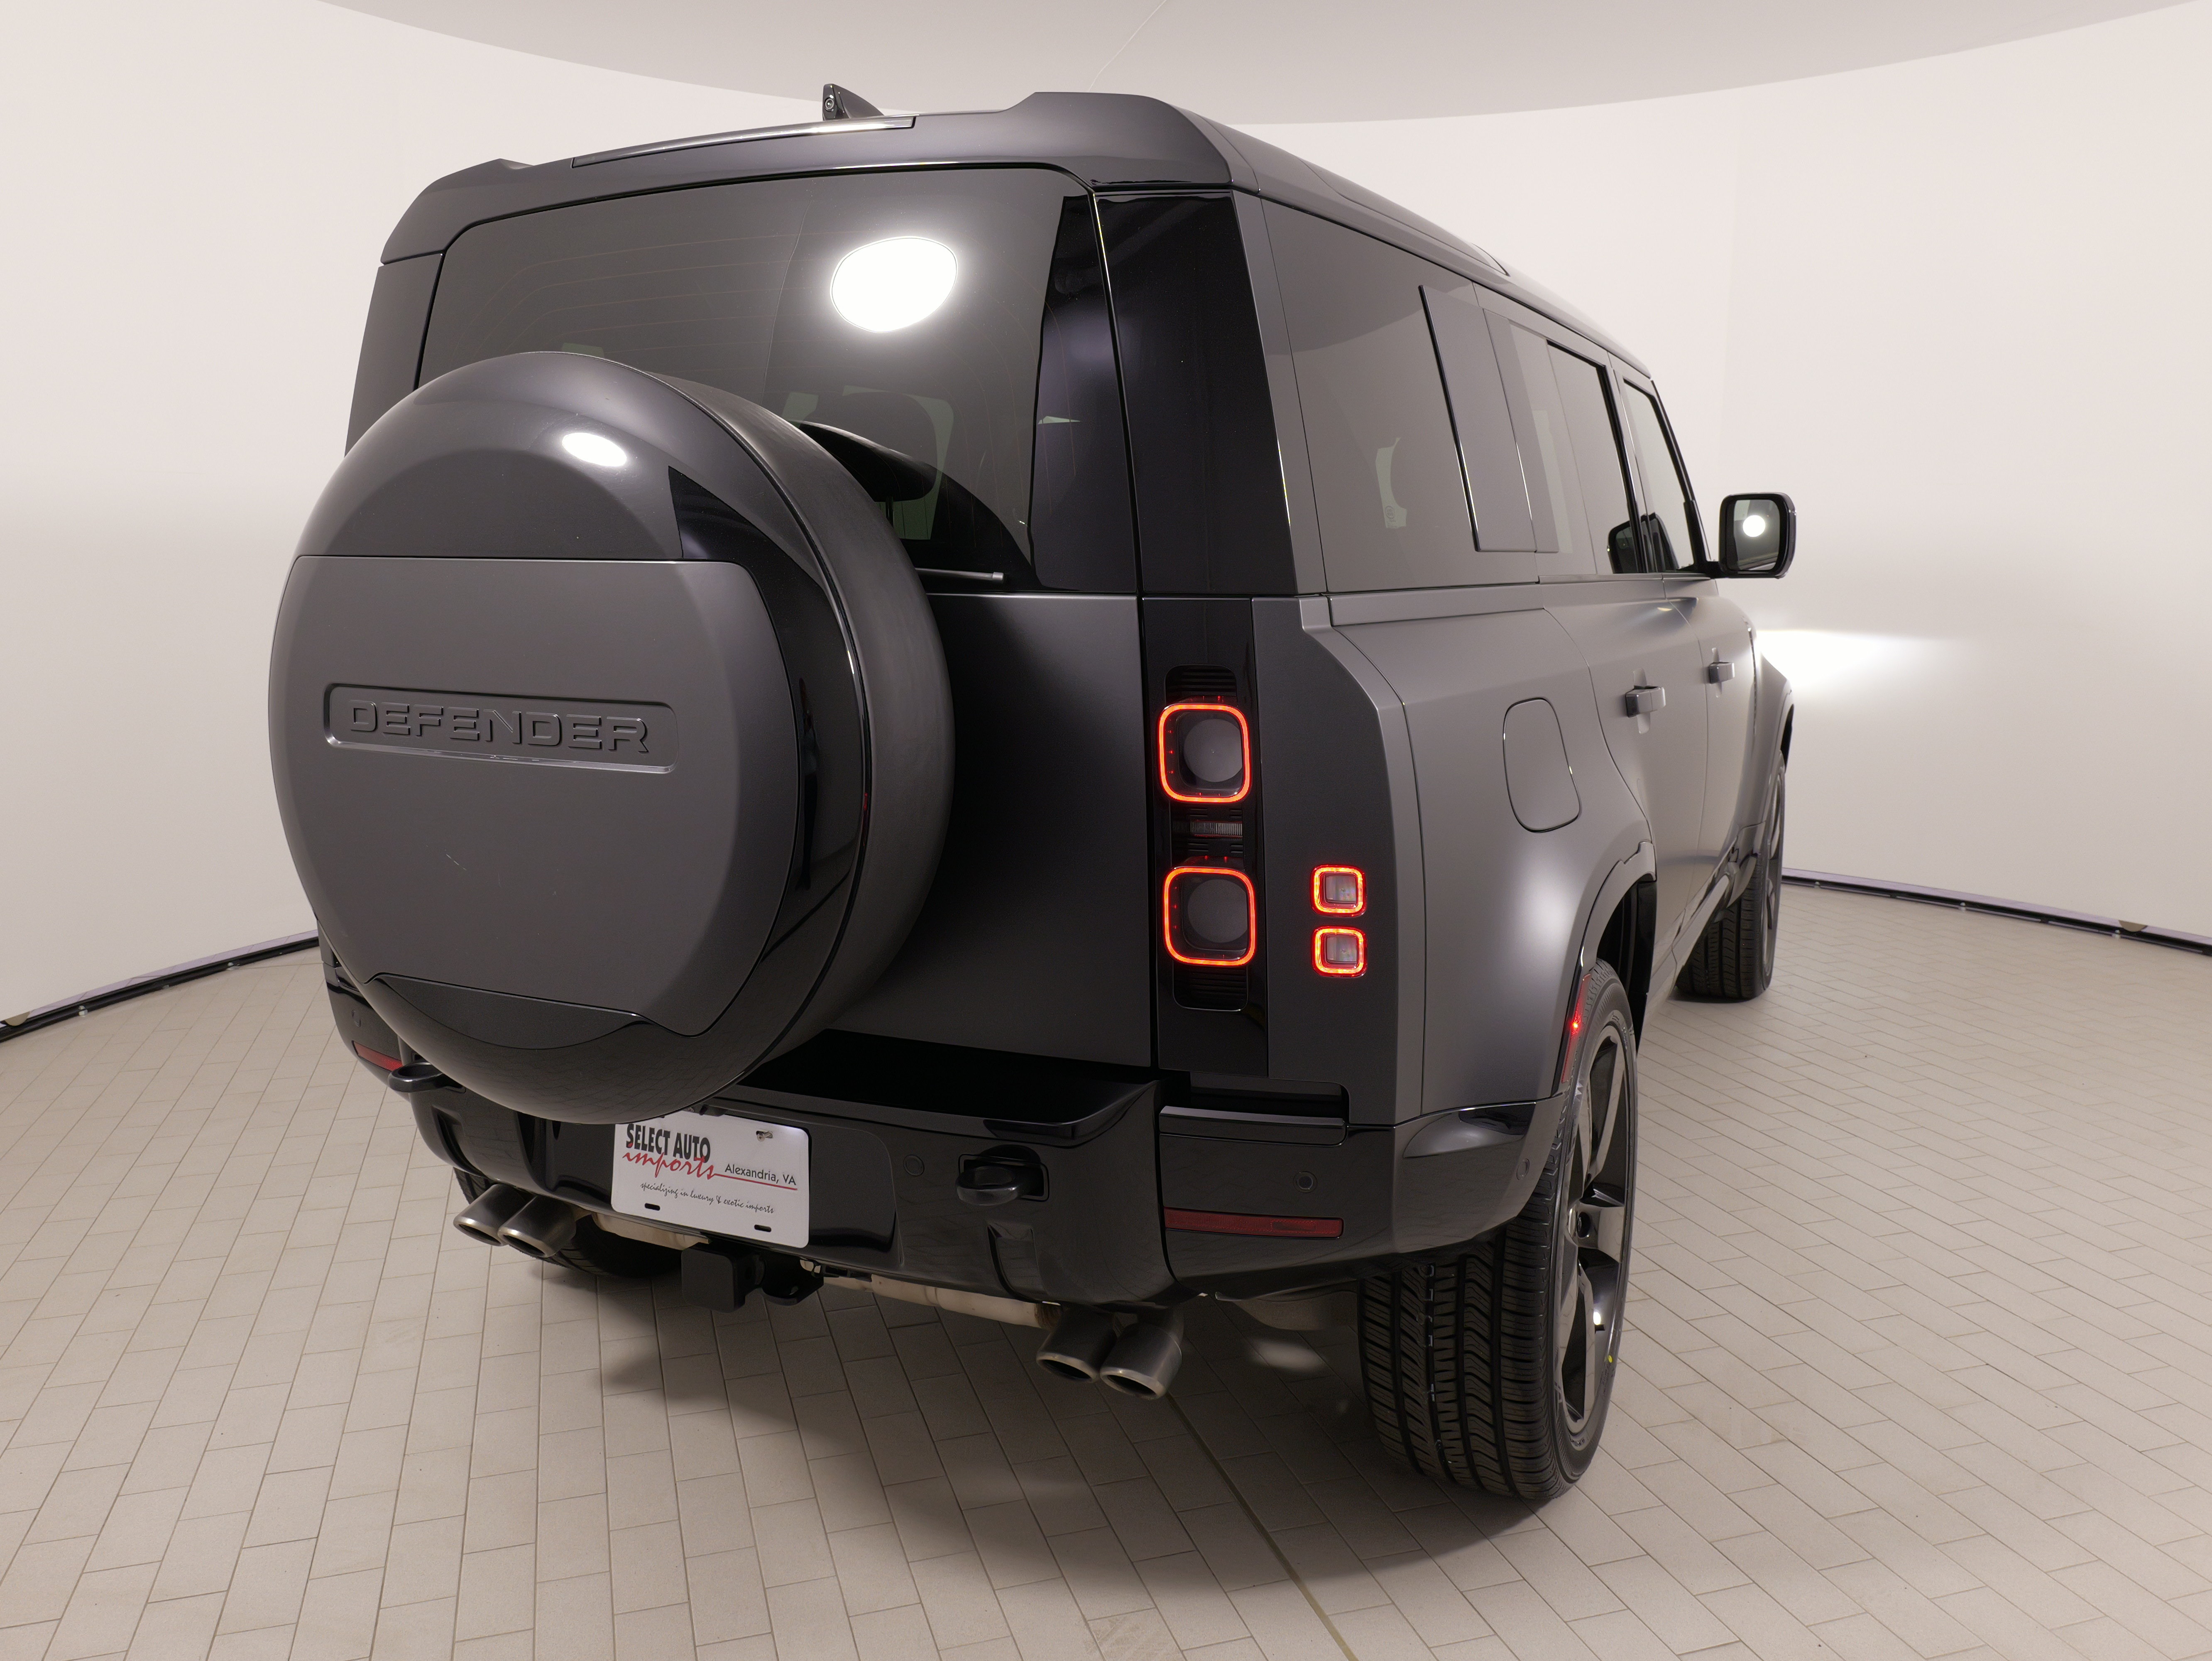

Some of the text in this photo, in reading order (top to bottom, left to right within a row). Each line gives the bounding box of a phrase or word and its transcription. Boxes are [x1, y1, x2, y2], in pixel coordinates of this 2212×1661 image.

[348, 699, 649, 753] DEFENDER
[626, 1123, 711, 1163] SELECT AUTO
[622, 1152, 715, 1180] imports
[724, 1164, 796, 1186] Alexandria, VA
[640, 1182, 679, 1198] specializing
[690, 1188, 714, 1205] luxury
[716, 1195, 721, 1204] &
[724, 1198, 744, 1208] exotic
[745, 1201, 775, 1214] imports
